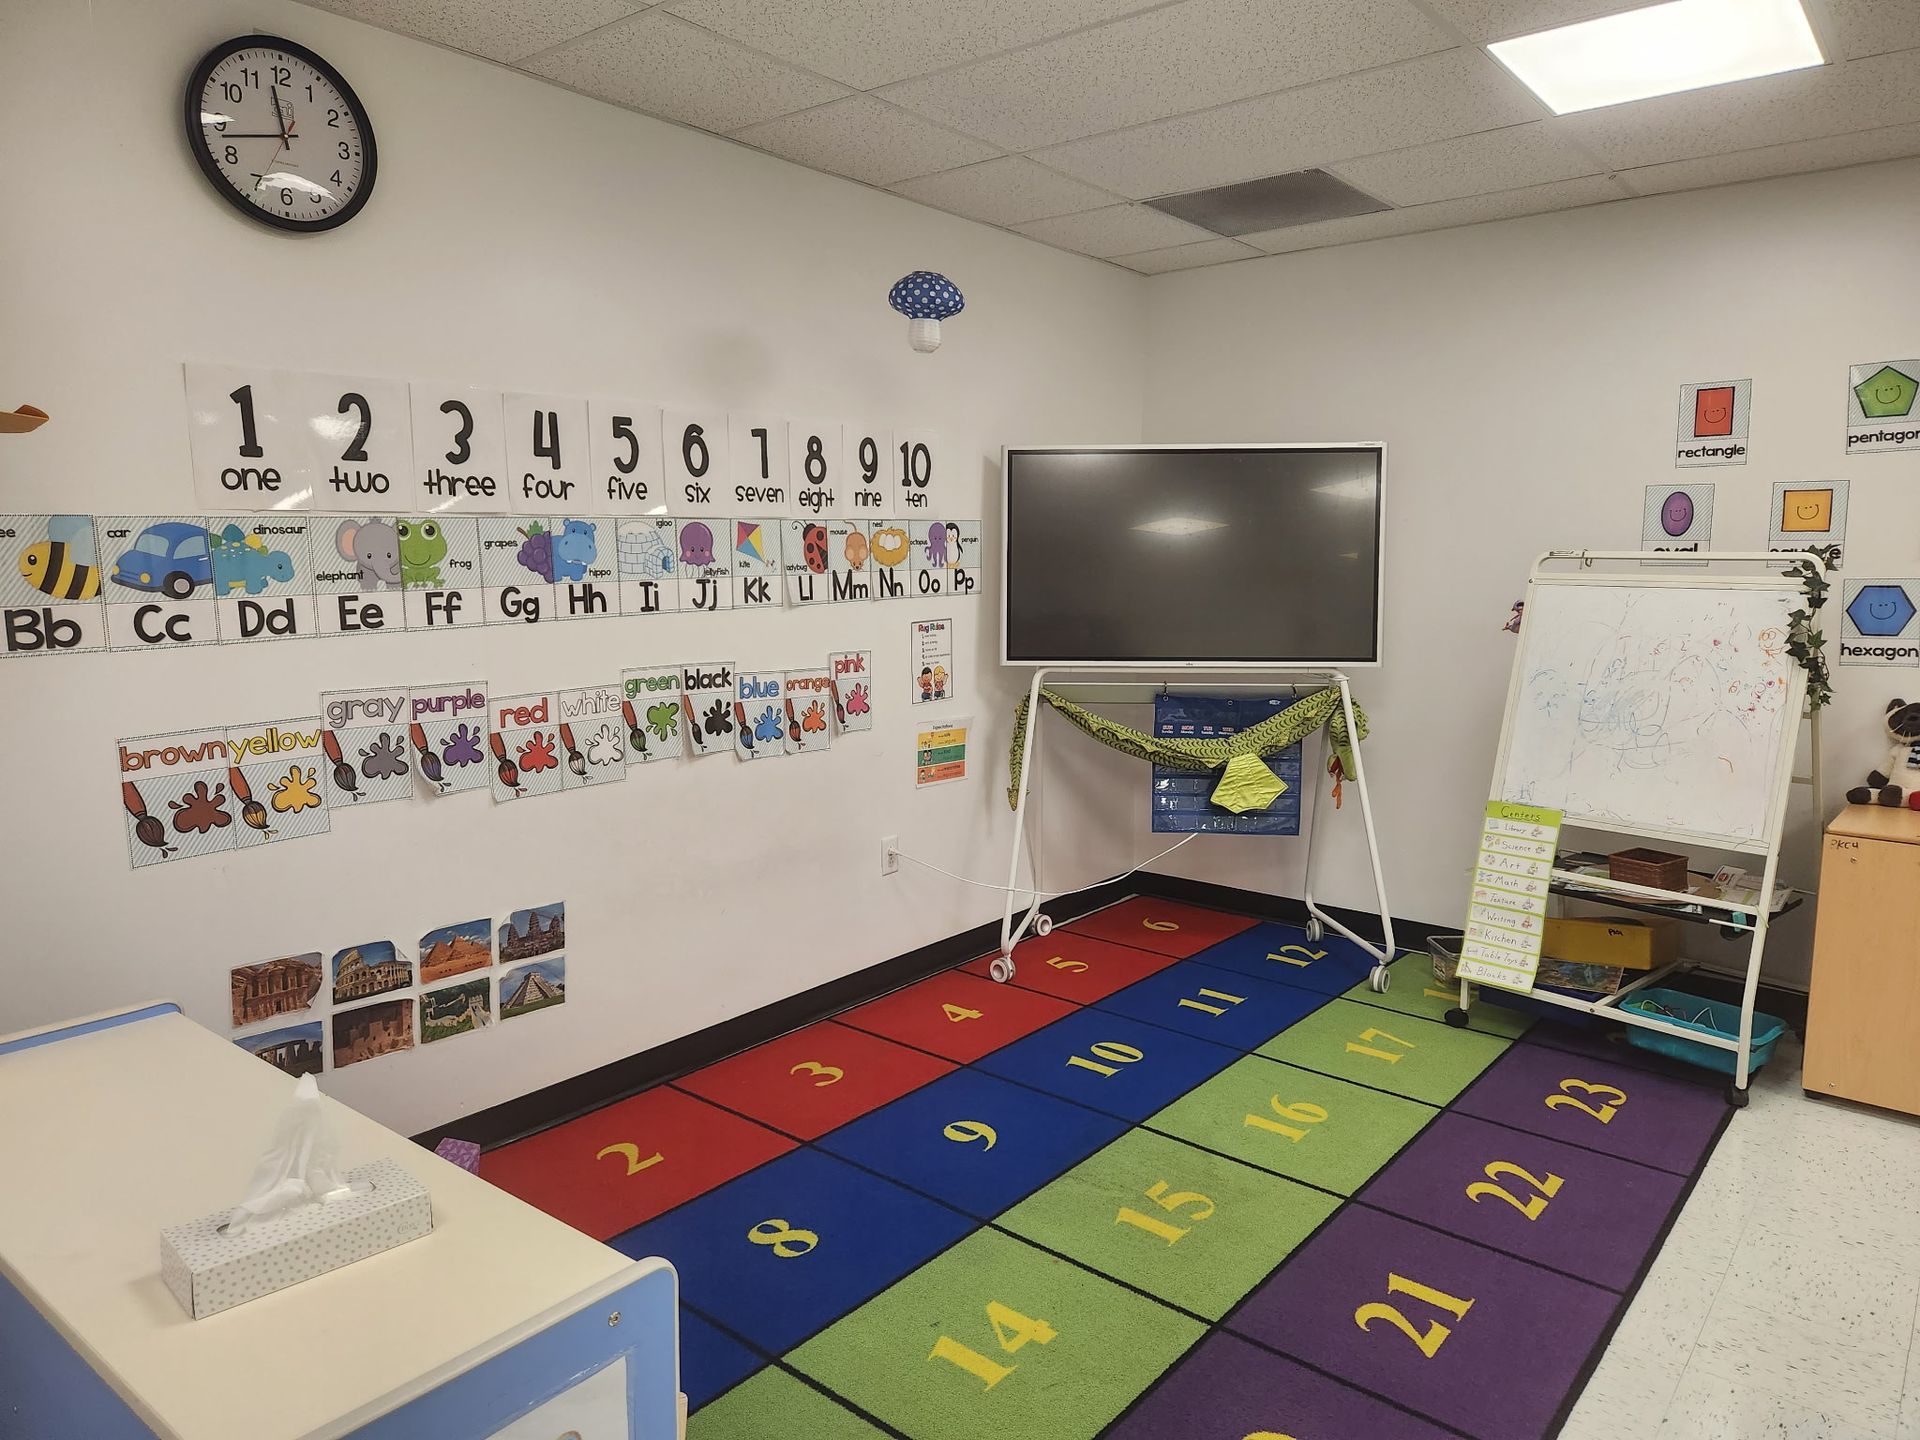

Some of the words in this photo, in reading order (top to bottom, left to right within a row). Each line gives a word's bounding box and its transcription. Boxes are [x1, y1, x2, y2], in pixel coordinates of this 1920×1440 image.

[241, 67, 260, 89] 11
[271, 65, 292, 87] 12
[220, 81, 243, 103] 10
[305, 84, 313, 103] 1
[327, 109, 339, 128] 2
[224, 145, 239, 165] 8
[338, 141, 350, 161] 3
[330, 169, 343, 187] 4
[280, 187, 293, 206] 6
[229, 385, 264, 458] 1
[337, 392, 372, 461] 2
[440, 400, 474, 465] 3
[533, 410, 561, 470] 4
[612, 416, 639, 473] 5
[682, 423, 710, 477] 6
[1677, 443, 1745, 459] rectangle
[751, 428, 768, 479] 7
[804, 435, 827, 484] 8
[858, 436, 878, 483] 9
[900, 441, 931, 488] 10
[221, 467, 281, 491] one
[329, 465, 390, 493] two
[424, 468, 496, 497] three
[522, 473, 575, 500] four
[607, 475, 648, 500] five
[685, 482, 711, 503] six
[735, 484, 784, 503] seven
[799, 487, 835, 513] eight
[854, 488, 882, 507] nine
[905, 490, 928, 508] ten
[107, 528, 131, 538] car
[253, 524, 307, 535] dinosaur
[656, 519, 673, 529] igloo
[484, 539, 518, 549] grapes
[316, 569, 364, 582] elephant
[450, 559, 472, 570] frog
[589, 567, 612, 577] hippo
[743, 577, 771, 603] Kk
[799, 575, 814, 601] Ll
[832, 569, 868, 601] Mm
[879, 567, 904, 598] Nn
[919, 569, 940, 593] Oo
[954, 568, 974, 595] Pp
[425, 591, 462, 625] Ff
[500, 587, 540, 623] Gg
[568, 583, 607, 614] Hh
[639, 581, 660, 612] Ii
[692, 579, 717, 611] Jj
[133, 604, 192, 643] Cc
[238, 598, 297, 638] Dd
[338, 595, 385, 631] Ee
[4, 607, 83, 651] Bb
[835, 653, 865, 675] pink
[1840, 643, 1920, 660] hexagon
[624, 674, 680, 699] green
[684, 667, 732, 690] black
[739, 676, 780, 699] blue
[786, 677, 830, 693] orange
[327, 696, 405, 729] gray
[411, 688, 486, 720] purple
[500, 697, 549, 728] red
[561, 690, 622, 717] white
[120, 740, 228, 772] brown
[227, 727, 322, 764] yellow
[1501, 805, 1541, 822] Centers
[1504, 823, 1527, 834] Library
[1502, 841, 1531, 851] Science
[1499, 858, 1520, 869] Art
[1495, 876, 1518, 887] Math
[1143, 915, 1179, 932] 6
[1046, 956, 1089, 973] 5
[1266, 944, 1329, 968] 12
[942, 1002, 984, 1023] 4
[1178, 987, 1248, 1018] 11
[1345, 1027, 1416, 1065] 17
[1065, 1041, 1144, 1079] 10
[790, 1061, 844, 1087] 3
[1544, 1077, 1628, 1124] 23
[1243, 1093, 1329, 1143] 16
[943, 1119, 997, 1152] 9
[596, 1142, 664, 1176] 2
[1465, 1160, 1565, 1221] 22
[1114, 1179, 1216, 1247] 15
[747, 1218, 820, 1258] 8
[1354, 1272, 1476, 1359] 21
[928, 1300, 1059, 1392] 14
